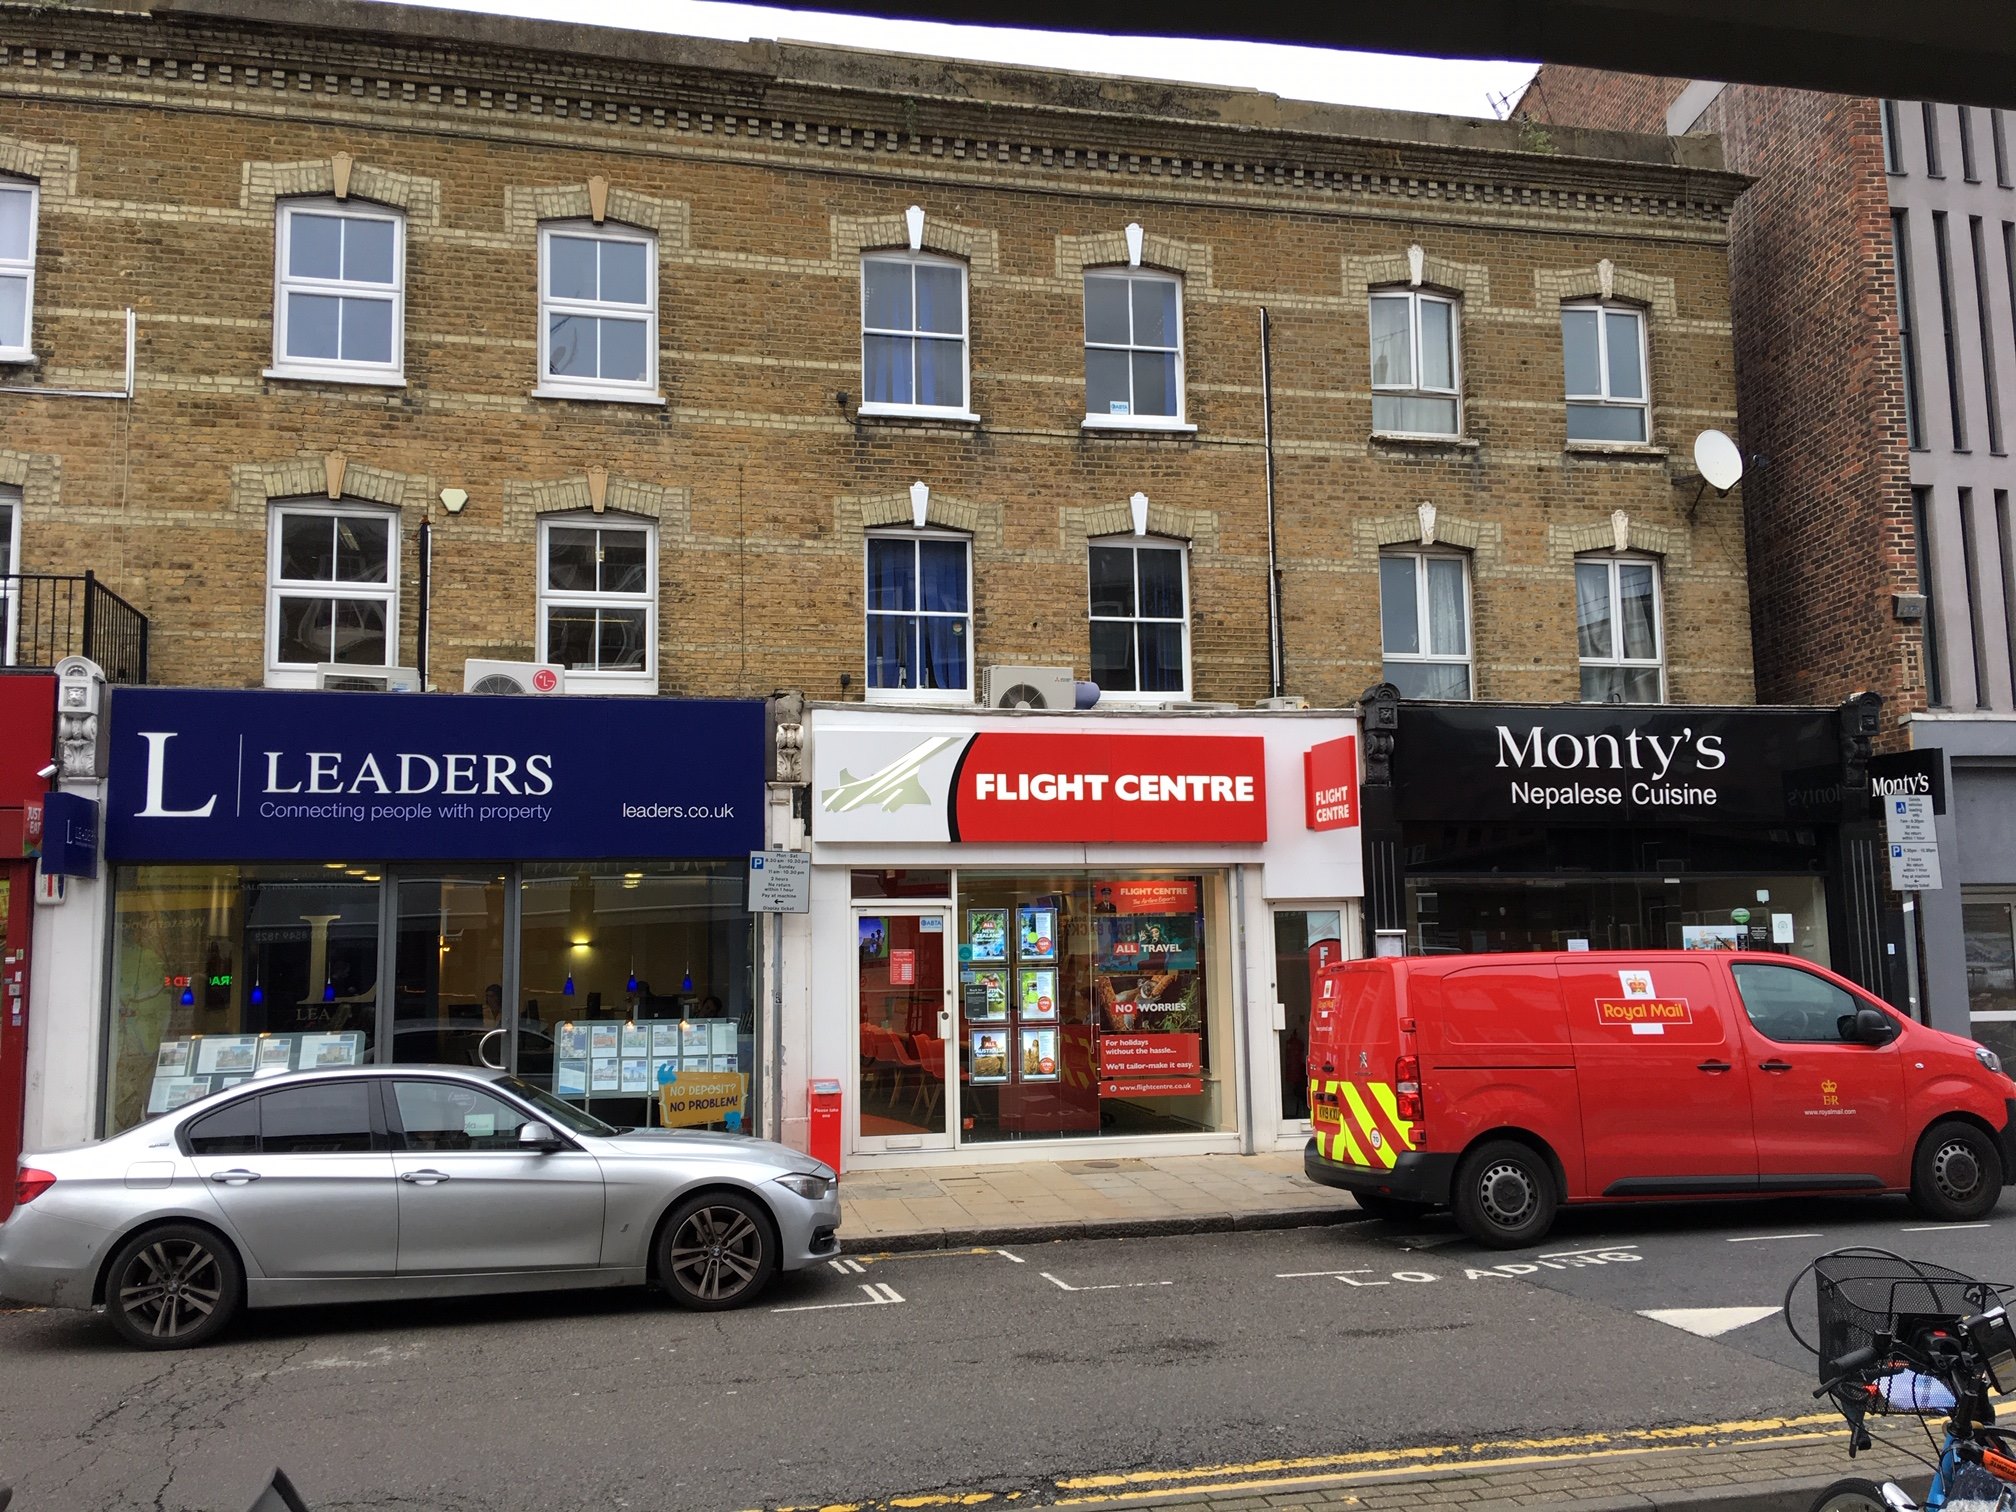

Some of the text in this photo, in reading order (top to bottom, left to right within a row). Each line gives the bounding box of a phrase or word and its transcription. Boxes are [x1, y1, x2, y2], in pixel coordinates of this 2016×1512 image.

[533, 669, 557, 692] LG
[133, 732, 217, 817] L
[262, 752, 553, 796] LEADERS
[976, 774, 1254, 802] FLIGHT CENTRE
[1315, 785, 1348, 806] FLIGHT
[1511, 782, 1717, 809] Nepalese Cuisine
[27, 806, 42, 820] JUST
[260, 802, 552, 822] Connecting people with property
[623, 803, 735, 819] leaders.co.uk
[1316, 804, 1349, 823] CENTRE
[29, 822, 42, 834] EAT
[1120, 887, 1188, 895] FLIGHT CENTRE
[1115, 943, 1182, 953] ALL TRAVEL
[1115, 1002, 1187, 1013] NO WORRIES
[1603, 1003, 1684, 1021] Royal Mail
[1119, 1039, 1149, 1047] holidays
[1126, 1061, 1168, 1070] tailor-make
[1176, 1061, 1194, 1069] easy.
[669, 1083, 737, 1096] NO DEPOSIT?
[1119, 1083, 1192, 1092] www.flightcentre.co.uk
[669, 1095, 738, 1112] NO PROBLEM!
[1823, 1095, 1839, 1105] ER
[1804, 1108, 1857, 1117] www.royalmail.com
[1372, 1135, 1379, 1143] 70
[1334, 1252, 1643, 1287] LOADING
